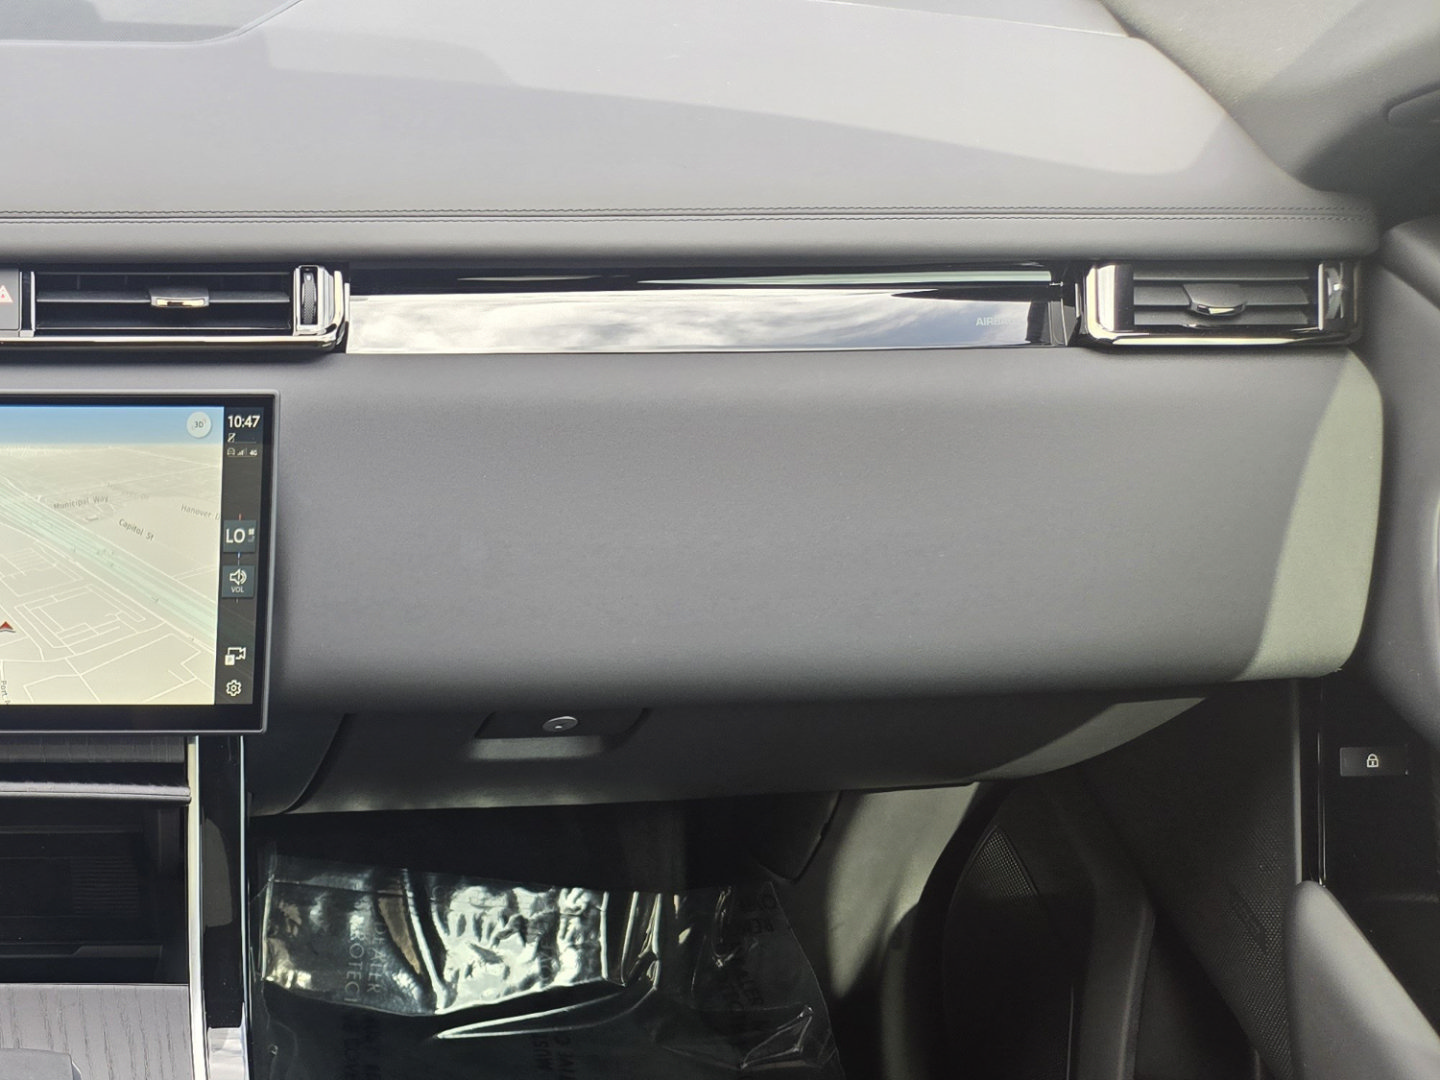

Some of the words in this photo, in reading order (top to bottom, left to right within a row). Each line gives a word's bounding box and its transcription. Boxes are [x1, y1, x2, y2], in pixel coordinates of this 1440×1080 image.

[194, 421, 204, 429] 3D
[227, 415, 260, 428] 10:47
[53, 497, 90, 510] Municipal
[180, 503, 212, 518] Hanover
[118, 518, 144, 537] Capitol
[145, 532, 155, 541] St
[225, 528, 246, 543] LO
[230, 586, 245, 594] VOL
